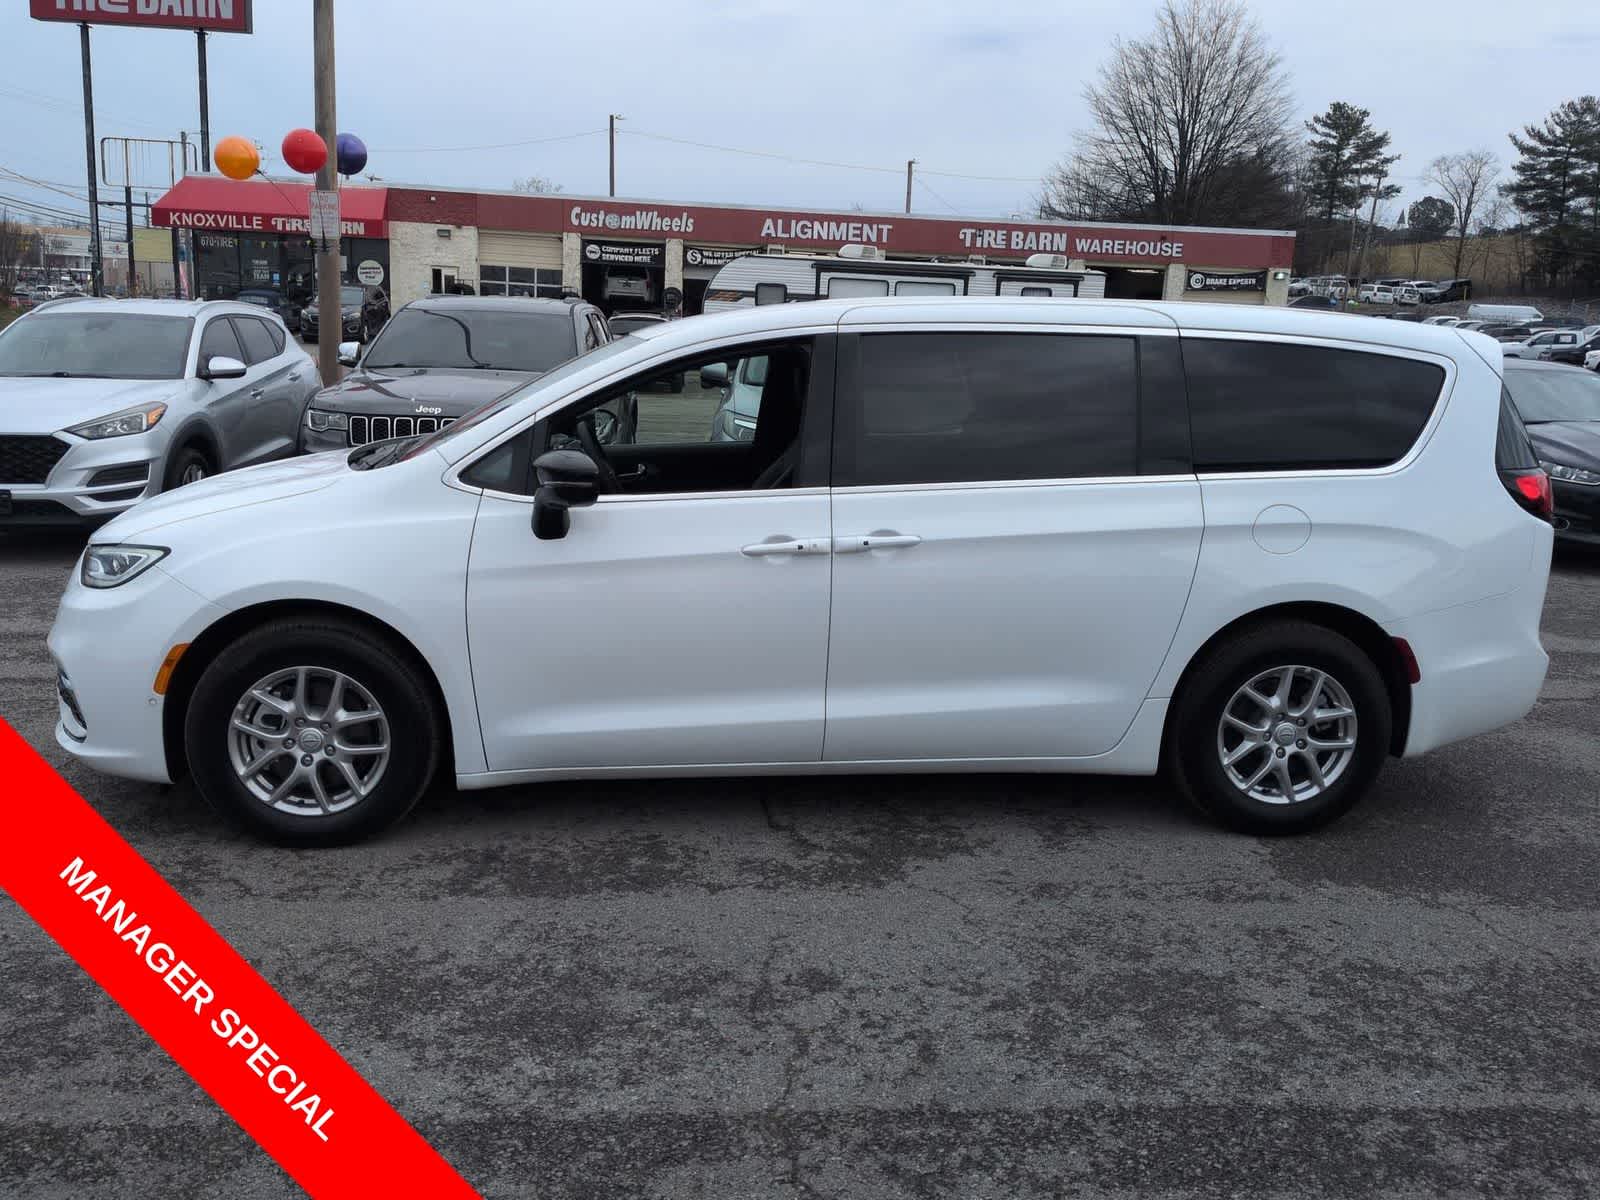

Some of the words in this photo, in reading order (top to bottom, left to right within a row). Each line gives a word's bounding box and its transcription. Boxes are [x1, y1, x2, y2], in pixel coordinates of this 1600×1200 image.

[169, 212, 263, 230] KNOXVILLE
[761, 218, 893, 243] ALIGNMENT
[1011, 231, 1067, 252] BARN
[1075, 238, 1184, 257] WAREHOUSE
[415, 405, 442, 415] Jeep
